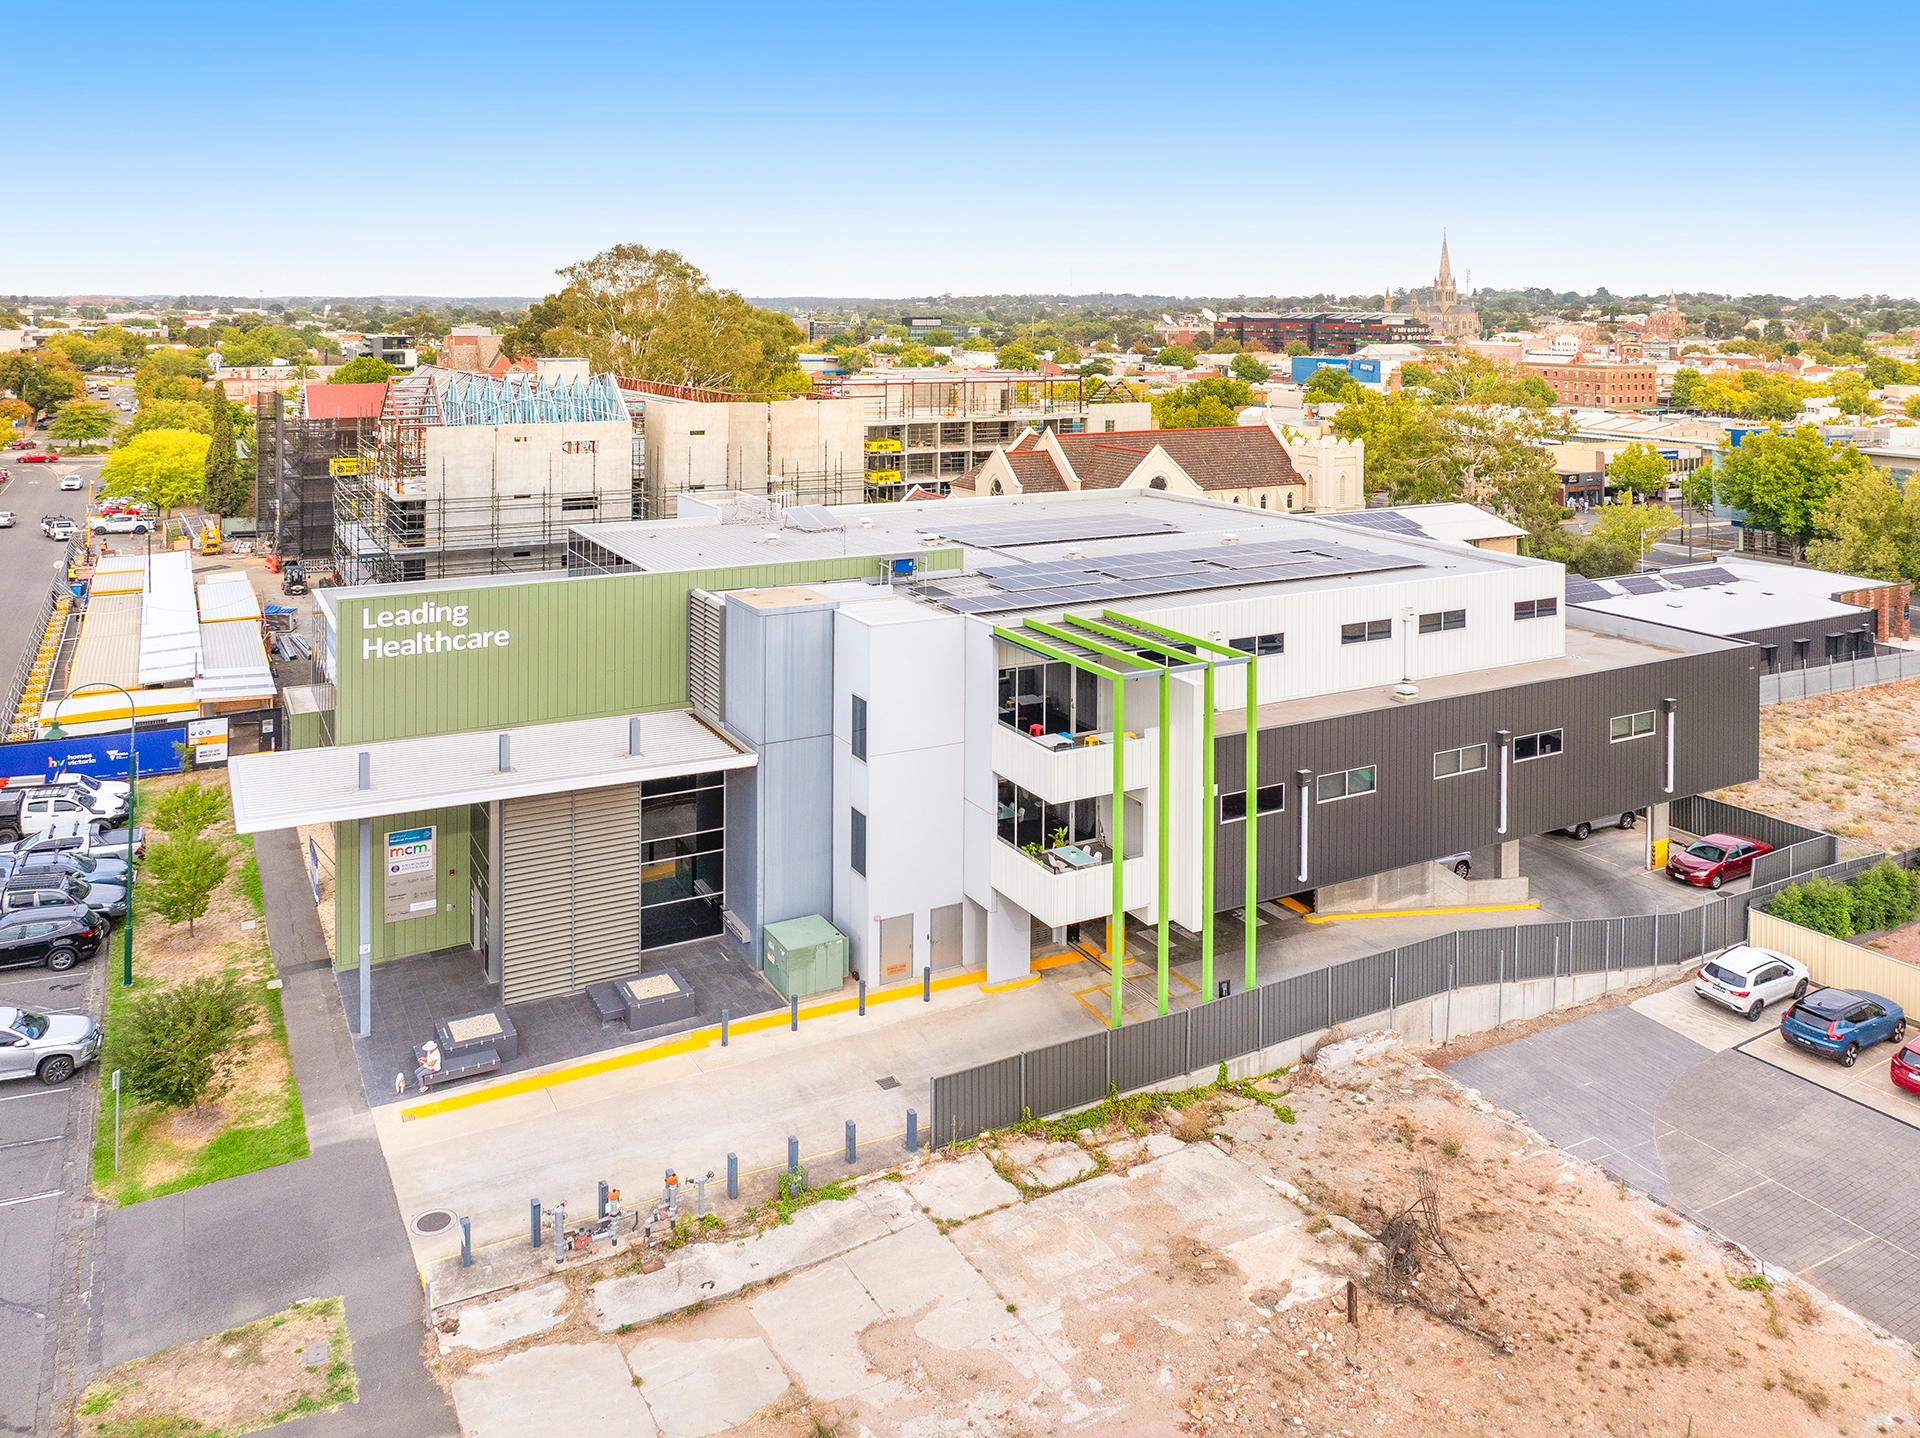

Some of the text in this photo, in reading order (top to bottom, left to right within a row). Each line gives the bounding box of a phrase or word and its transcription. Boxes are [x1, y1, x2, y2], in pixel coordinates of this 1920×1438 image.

[362, 601, 469, 629] Leading
[362, 629, 511, 660] Healthcare
[48, 756, 65, 768] hv
[67, 758, 97, 766] victoria
